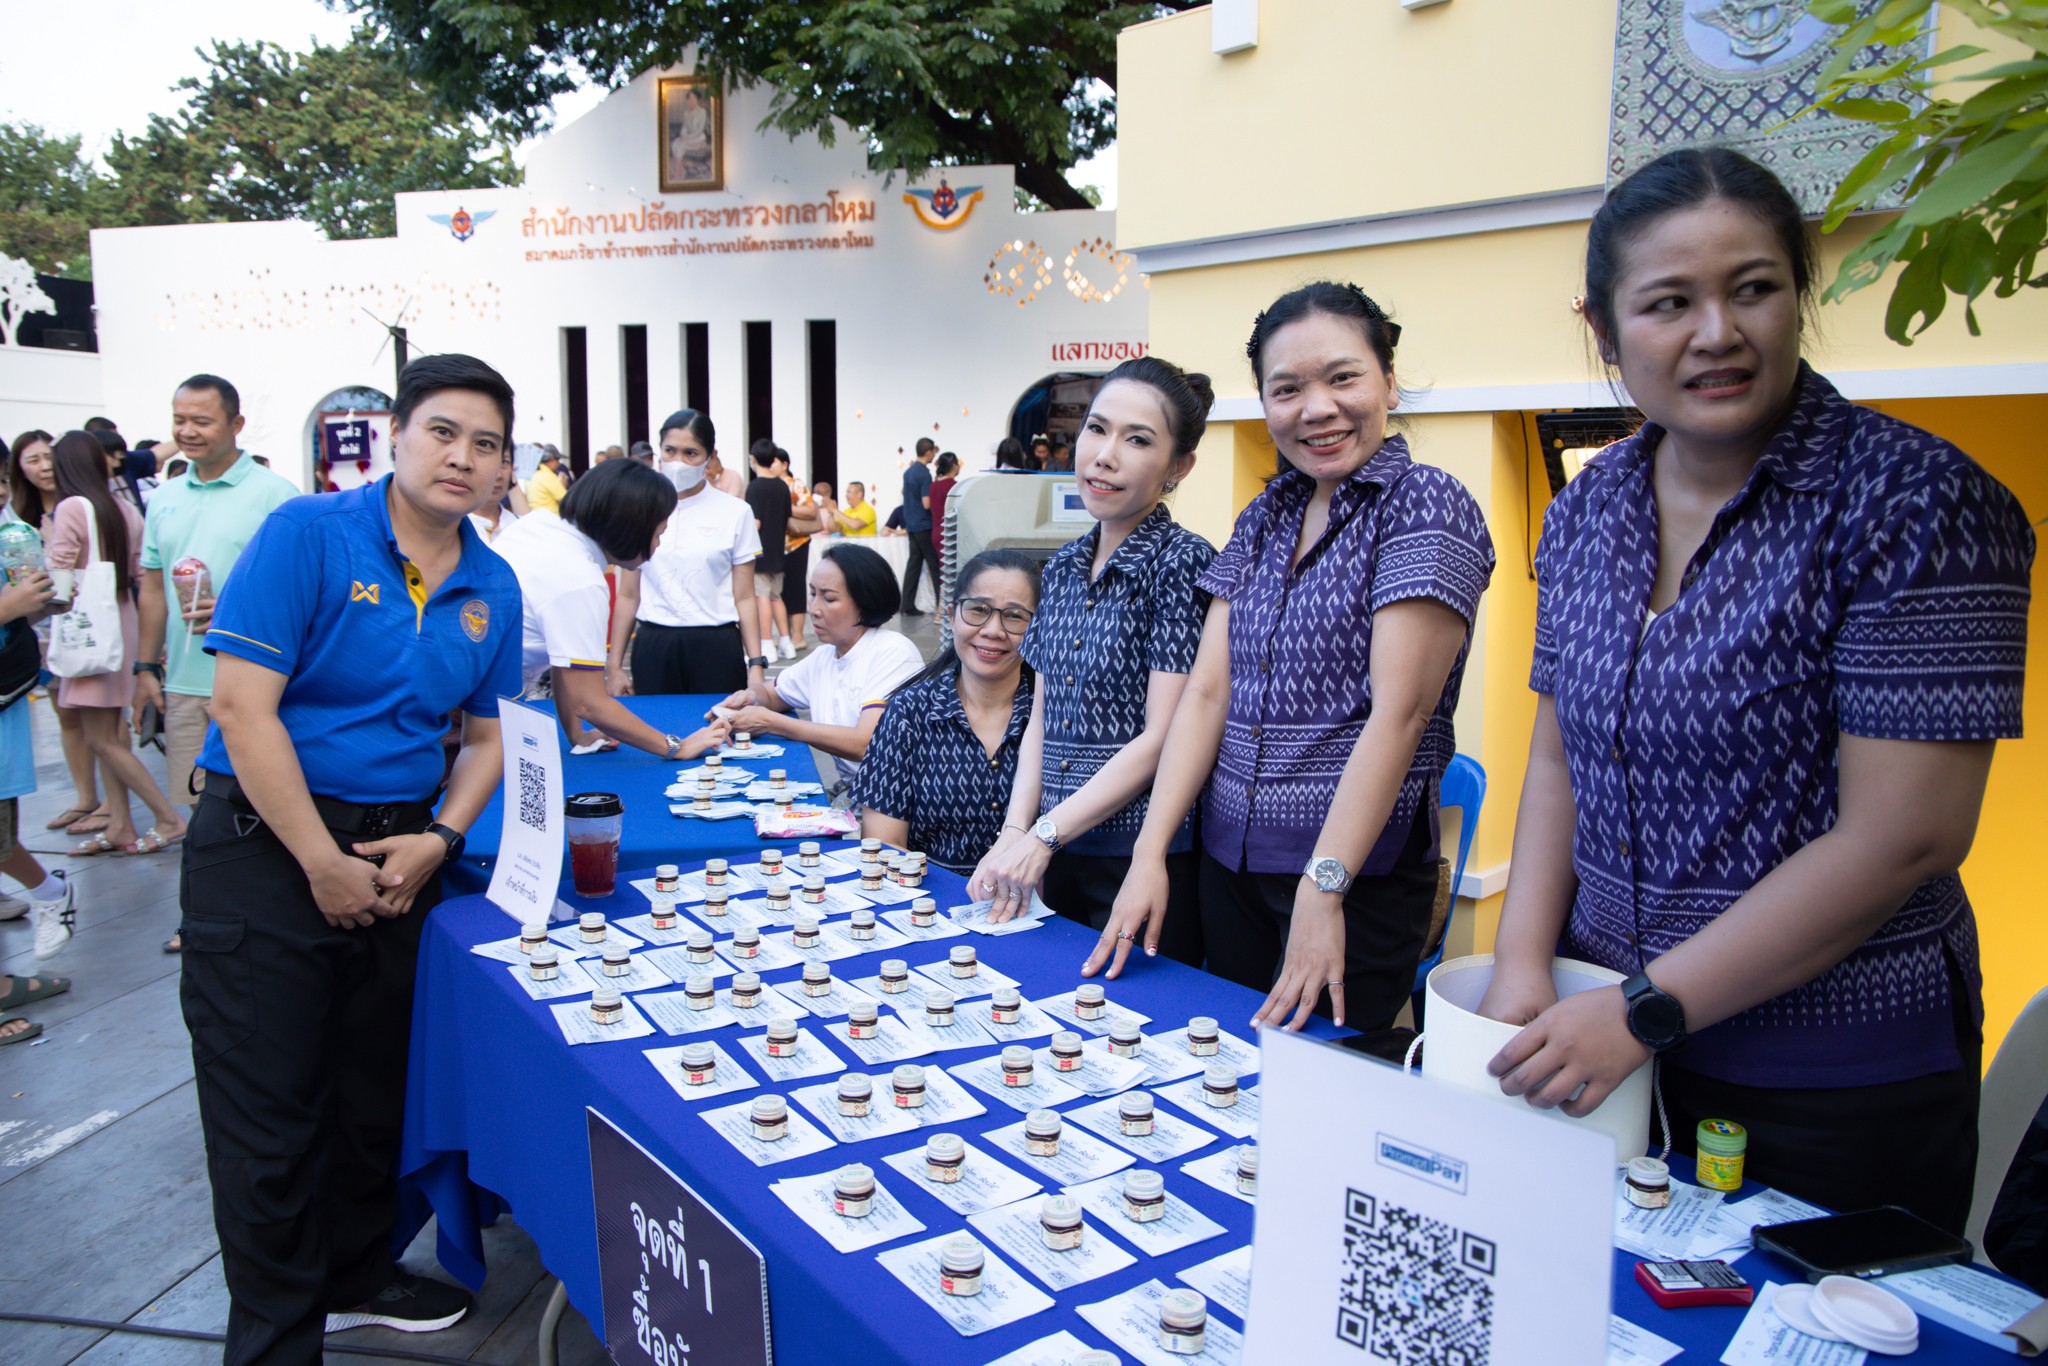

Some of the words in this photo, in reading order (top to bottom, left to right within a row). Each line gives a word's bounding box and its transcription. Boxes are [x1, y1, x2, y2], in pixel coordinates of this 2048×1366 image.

[521, 189, 876, 238] สำนักงานปลัดกระทรวงกลาโหม
[354, 427, 362, 437] 2
[630, 1201, 689, 1290] จุดที่
[698, 1259, 713, 1315] 1
